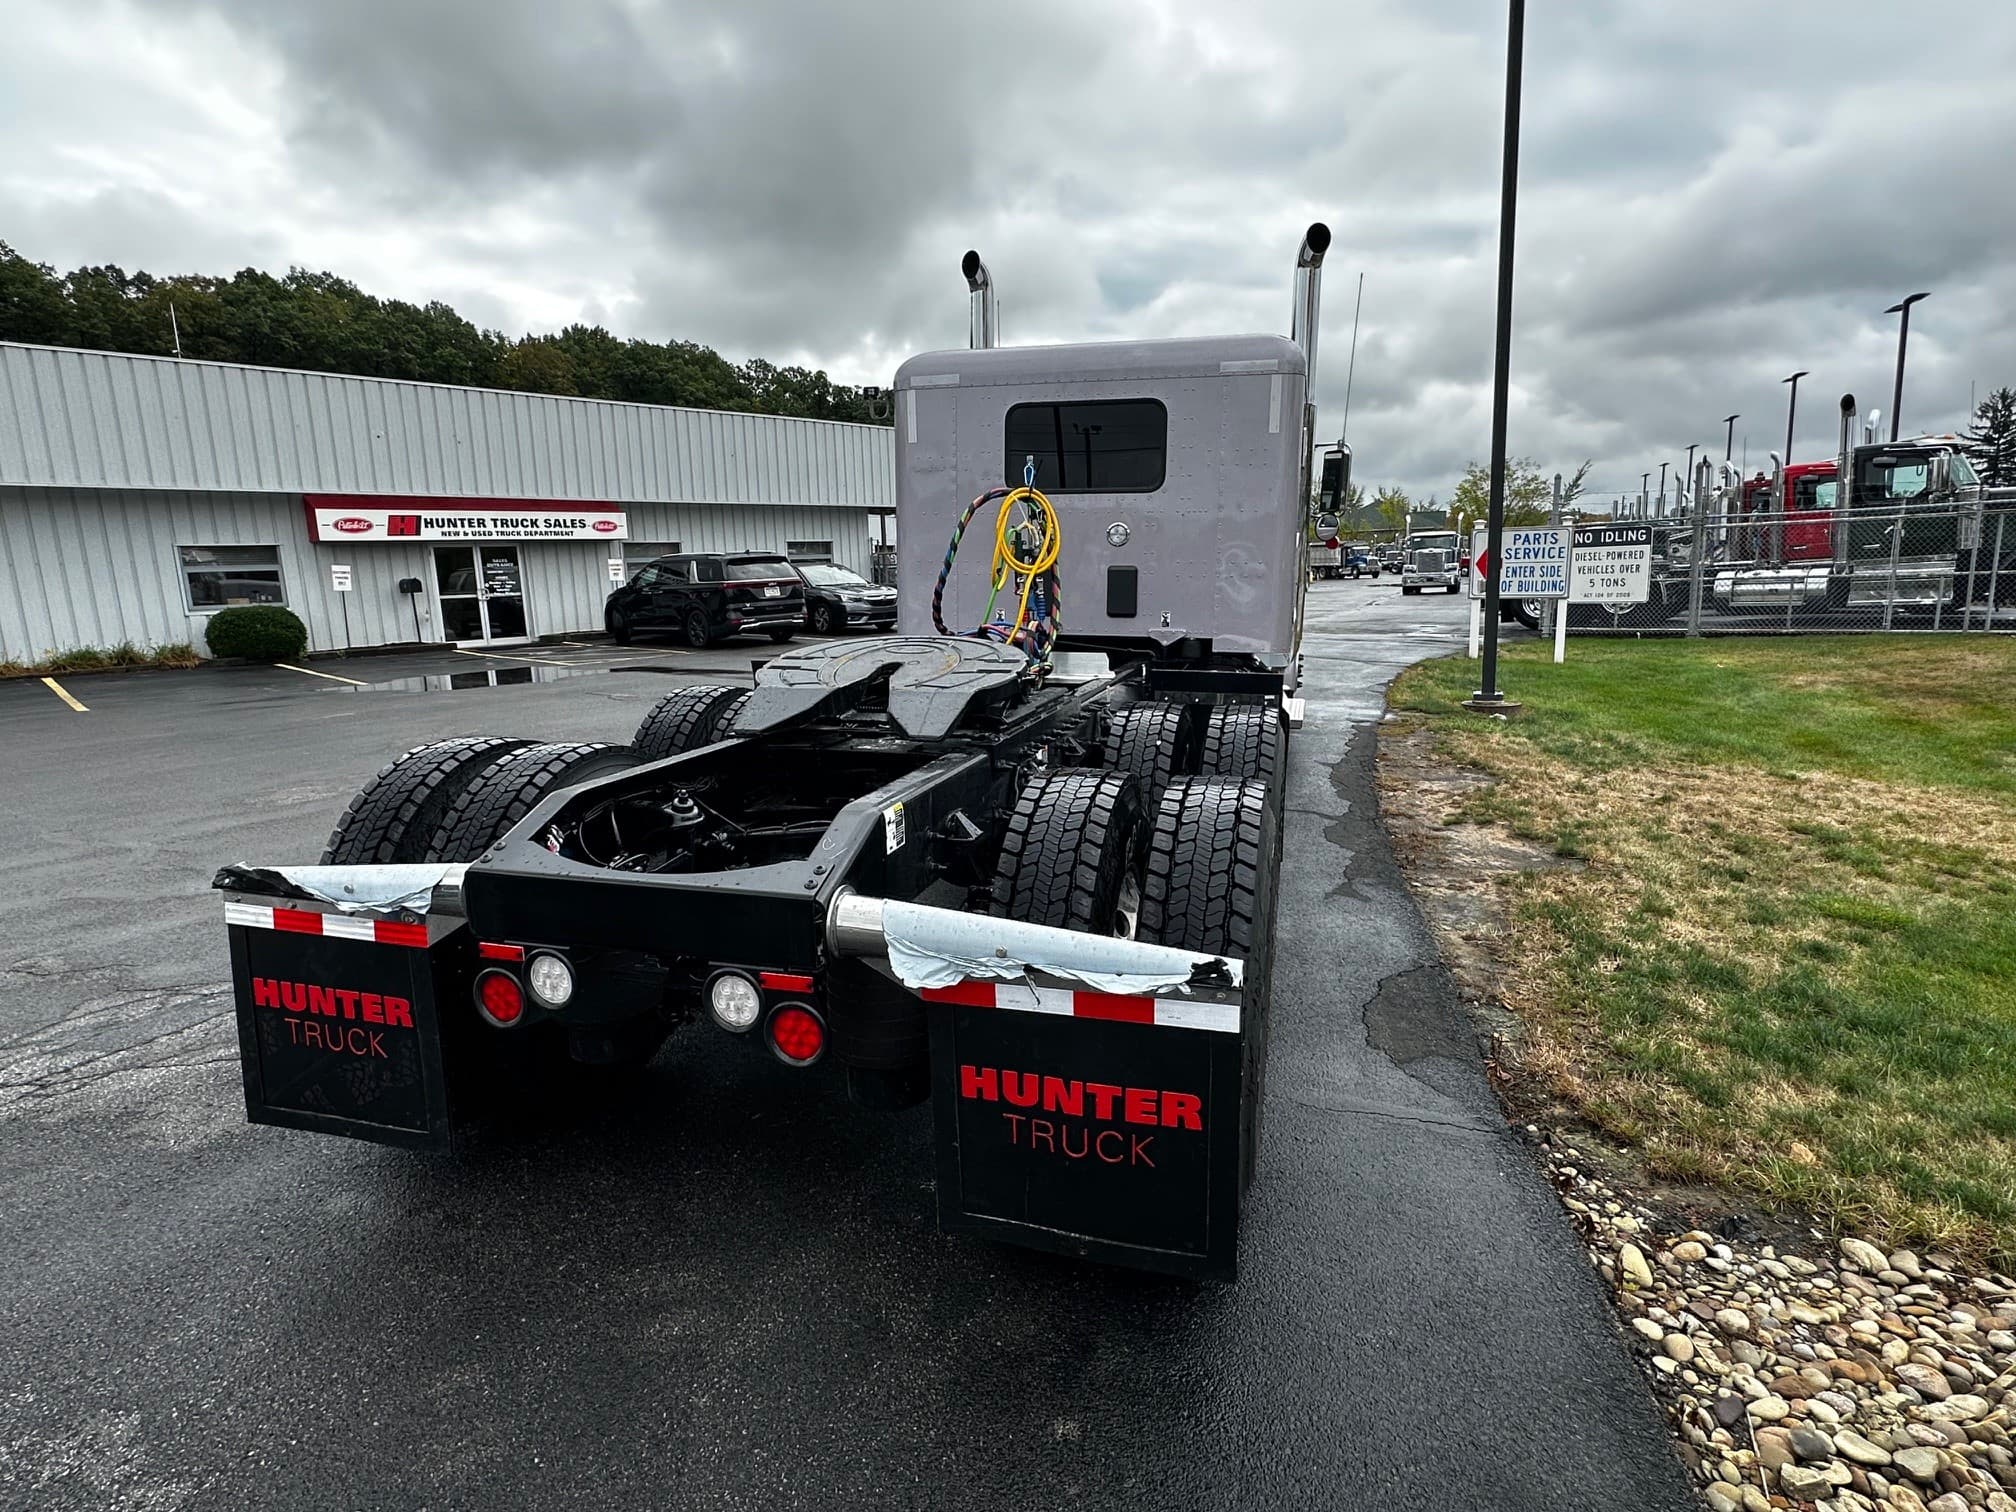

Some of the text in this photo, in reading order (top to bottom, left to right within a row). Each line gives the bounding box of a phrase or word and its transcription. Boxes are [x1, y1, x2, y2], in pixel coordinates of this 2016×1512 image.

[423, 517, 587, 529] HUNTER TRUCK SALES
[1513, 532, 1559, 546] PARTS
[1574, 529, 1647, 544] NO IDLING
[1504, 546, 1566, 560] SERVICE
[1575, 550, 1644, 562] DIESEL-POWERED
[1505, 565, 1562, 578] ENTER SIDE
[1577, 563, 1641, 575] VEHICLES OVER
[1500, 580, 1564, 593] OF BUILDING
[1589, 577, 1626, 588] 5 TONS
[252, 977, 414, 1029] HUNTER
[284, 1017, 389, 1059] TRUCK
[960, 1065, 1203, 1131] HUNTER
[1002, 1113, 1156, 1168] TRUCK
